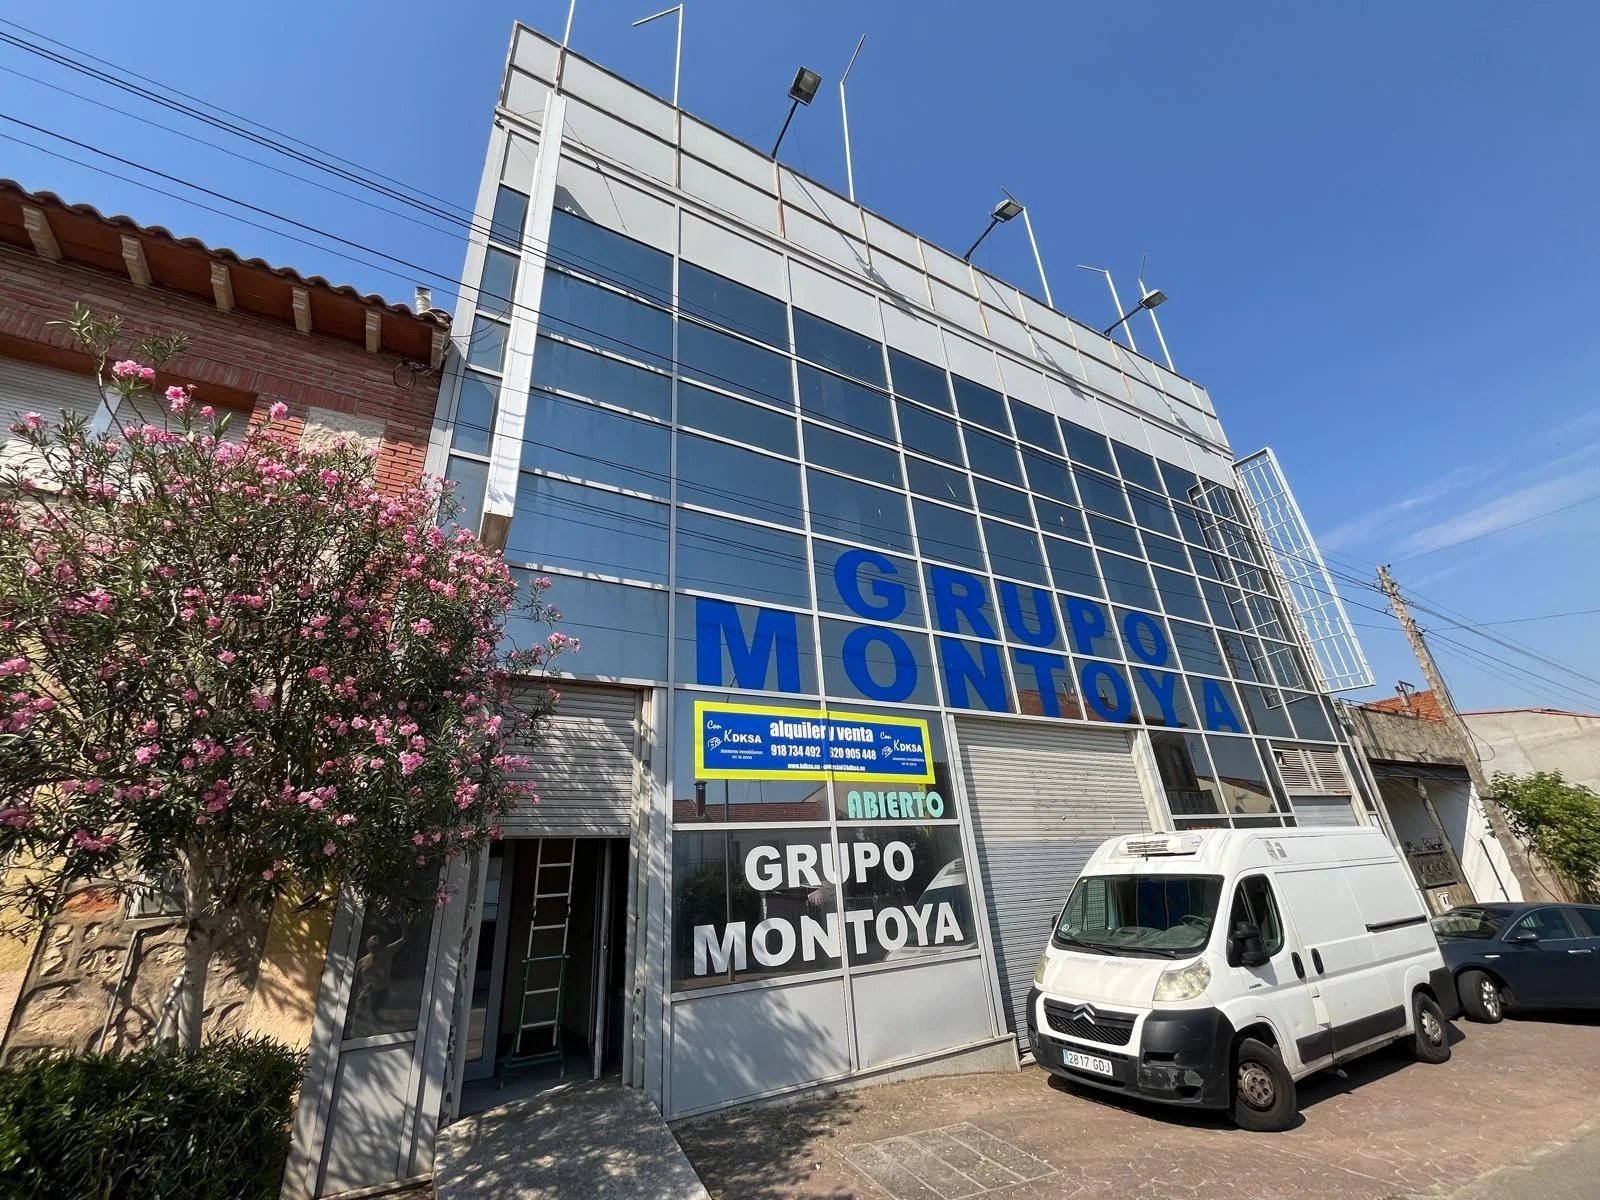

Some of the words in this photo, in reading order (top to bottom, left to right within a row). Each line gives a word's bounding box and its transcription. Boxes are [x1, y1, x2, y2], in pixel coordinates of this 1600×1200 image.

[834, 549, 1168, 667] GRUPO
[695, 596, 1244, 733] MONTOYA
[707, 720, 722, 730] Con
[770, 720, 826, 740] alquiler
[828, 725, 835, 741] y
[836, 726, 874, 743] venta
[770, 744, 786, 757] 918
[788, 745, 803, 757] 734
[805, 745, 821, 758] 492
[845, 747, 861, 760] 905
[862, 748, 877, 760] 448
[848, 790, 944, 818] ABIERTO
[745, 841, 914, 891] GRUPO
[693, 902, 964, 976] MONTOYA
[1069, 1052, 1090, 1067] 2817
[1093, 1059, 1110, 1073] GDJ
